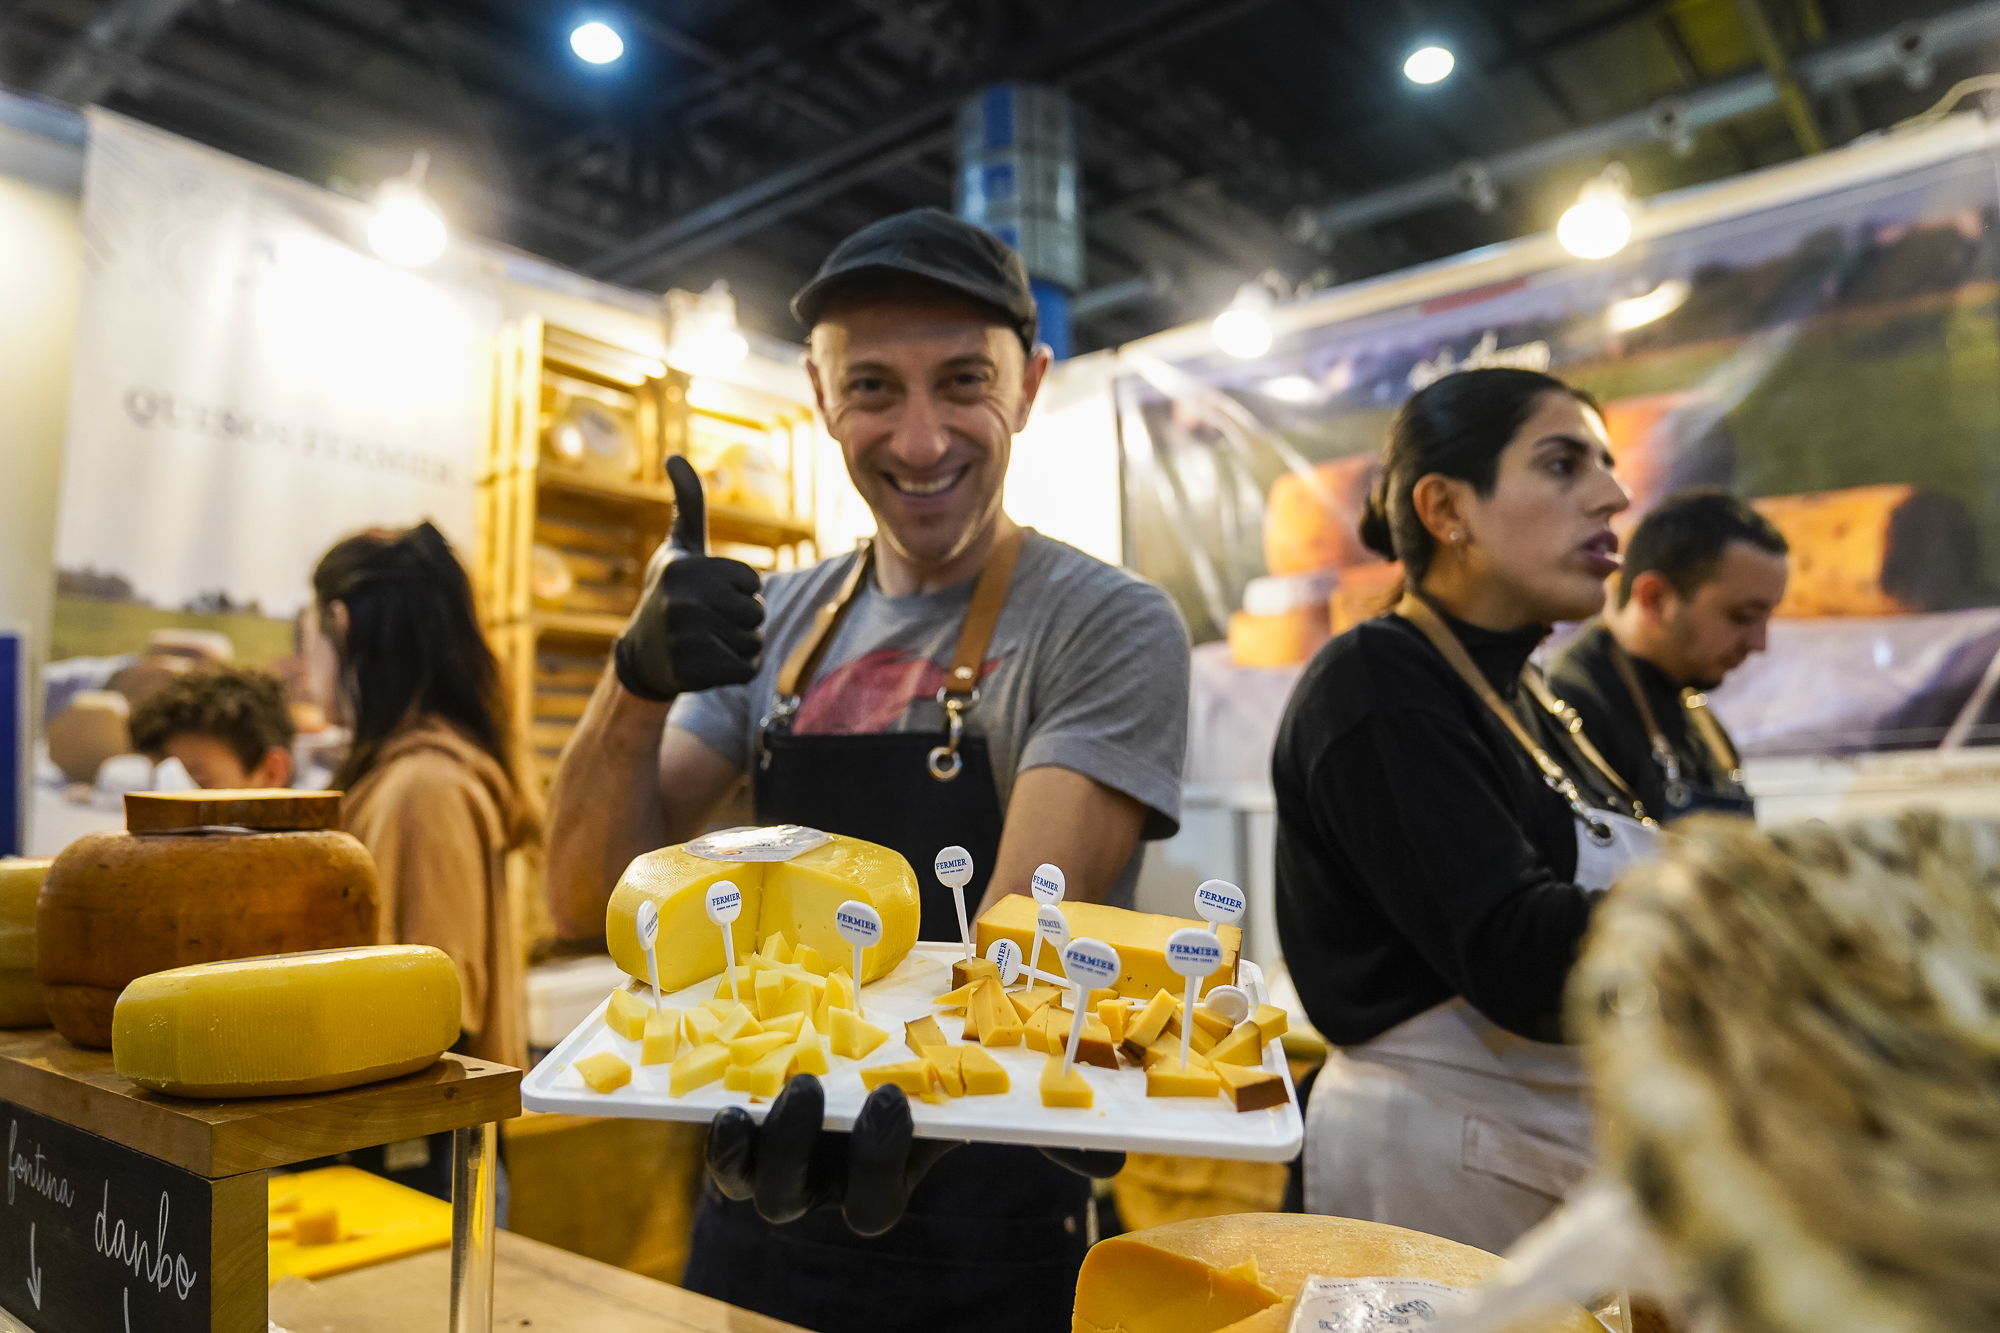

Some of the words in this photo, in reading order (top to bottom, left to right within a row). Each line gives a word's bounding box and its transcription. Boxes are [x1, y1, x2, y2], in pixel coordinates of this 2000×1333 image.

[936, 859, 967, 870] FERMIER
[1032, 875, 1059, 892] FERMIER
[711, 892, 741, 907] FERMIER
[1199, 889, 1242, 910] FERMIER
[837, 912, 877, 932] FERMIER
[1169, 943, 1220, 957] FERMIER
[1066, 950, 1115, 972] FERMIER
[8, 1119, 75, 1208] fontina
[94, 1179, 197, 1300] danbo
